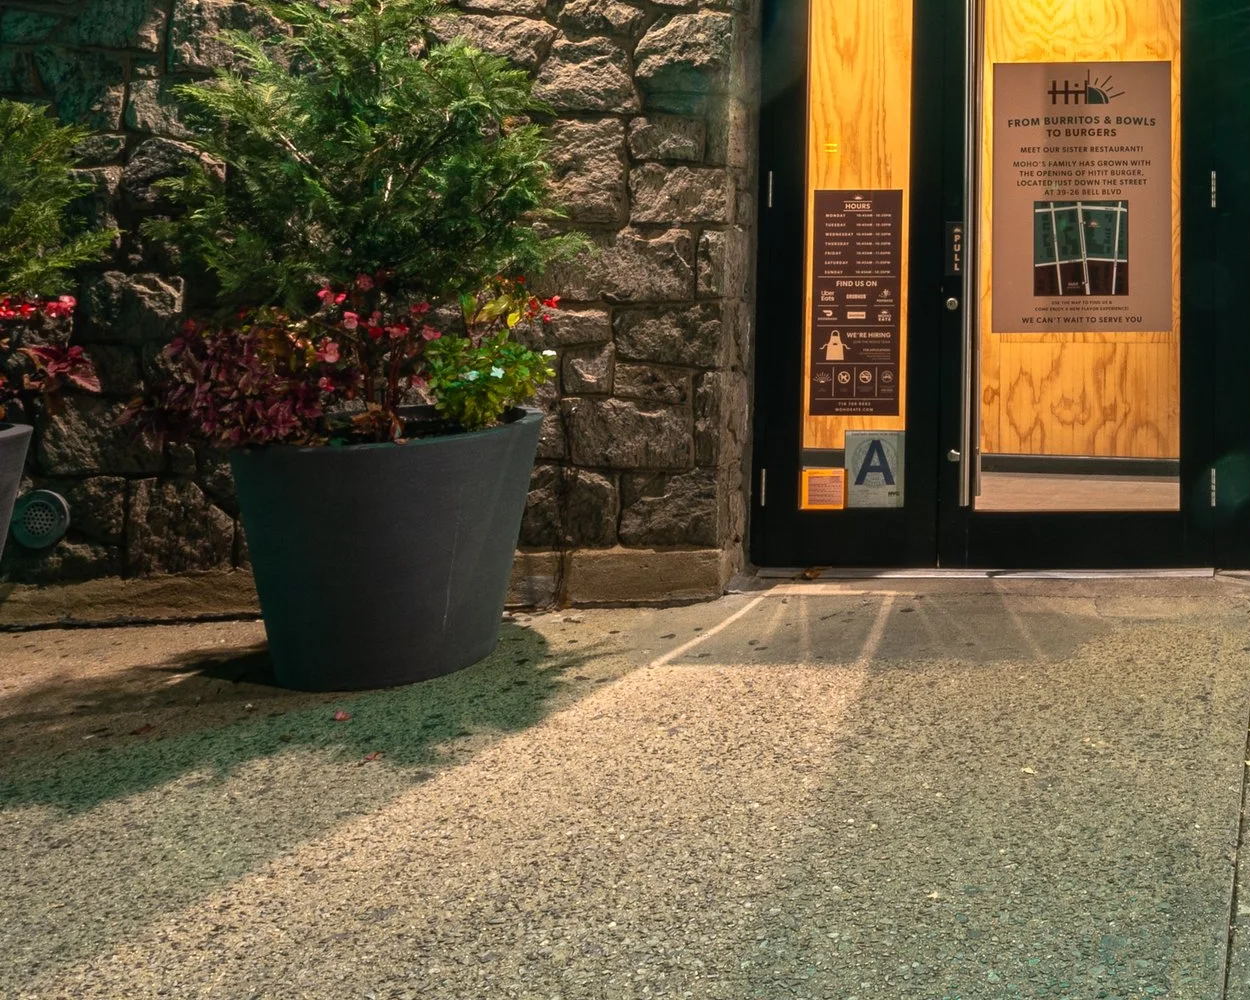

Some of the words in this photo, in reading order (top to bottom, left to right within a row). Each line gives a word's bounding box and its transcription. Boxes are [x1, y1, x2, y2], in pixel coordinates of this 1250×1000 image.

[1008, 118, 1040, 128] FROM
[1044, 116, 1100, 126] BURRITOS
[1104, 116, 1112, 124] &
[1116, 116, 1156, 126] BOWLS
[1065, 129, 1117, 137] BURGERS
[855, 440, 895, 485] A
